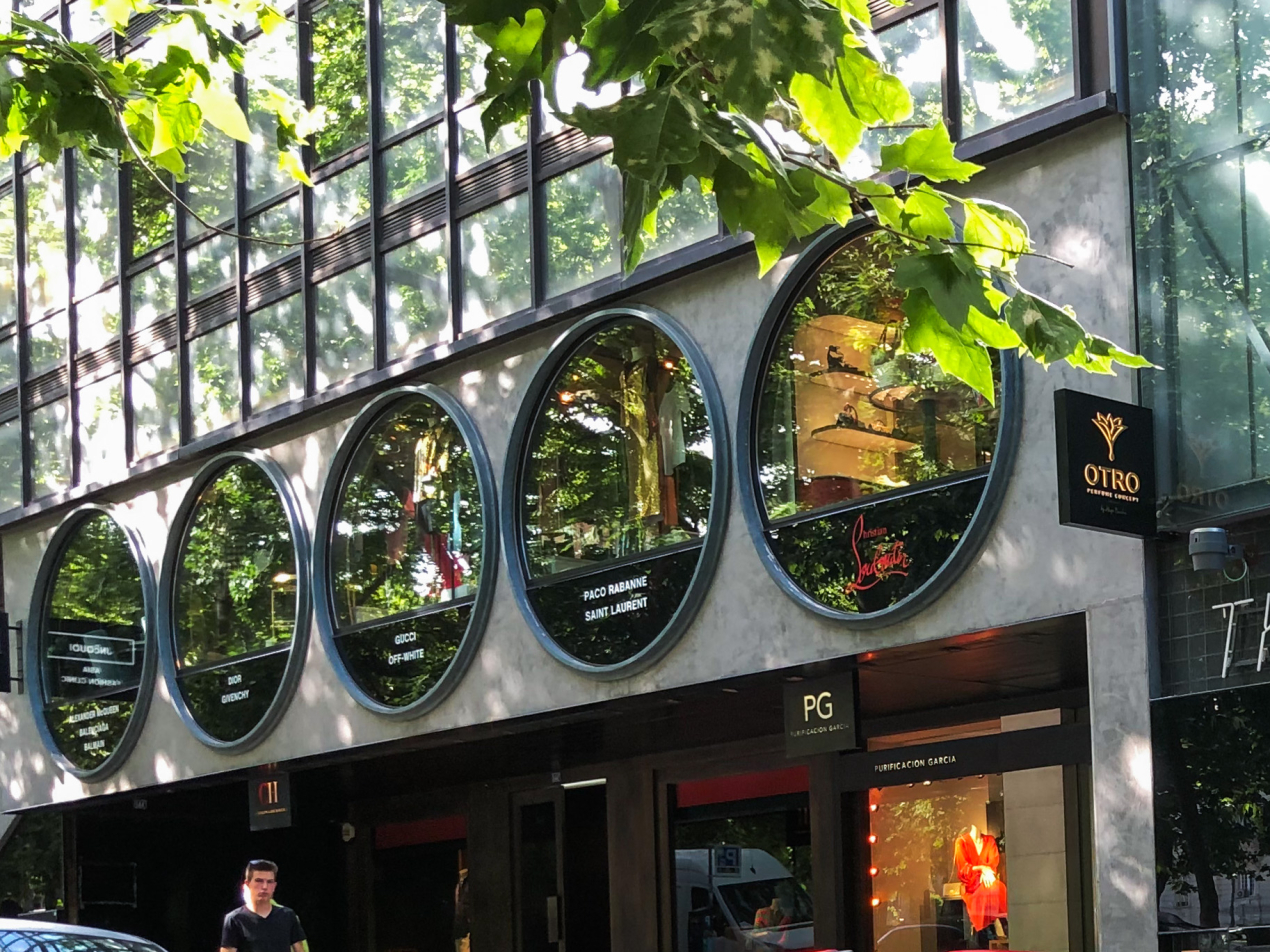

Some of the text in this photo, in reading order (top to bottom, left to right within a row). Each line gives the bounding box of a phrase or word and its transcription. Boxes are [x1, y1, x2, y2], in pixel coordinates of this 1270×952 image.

[1084, 463, 1141, 494] OTRO
[1086, 488, 1139, 503] PERFUME CONCEPT
[583, 575, 648, 602] PACO RABANNE
[584, 597, 648, 622] SAINT LAURENT
[394, 631, 417, 645] GUCCI
[388, 648, 425, 666] OFF-WHITE
[227, 674, 242, 686] DIOR
[221, 689, 250, 704] GIVENCHY
[803, 691, 834, 722] PG
[69, 709, 96, 724] ALEXANDER
[874, 755, 957, 774] PURIFICACION GARCIA
